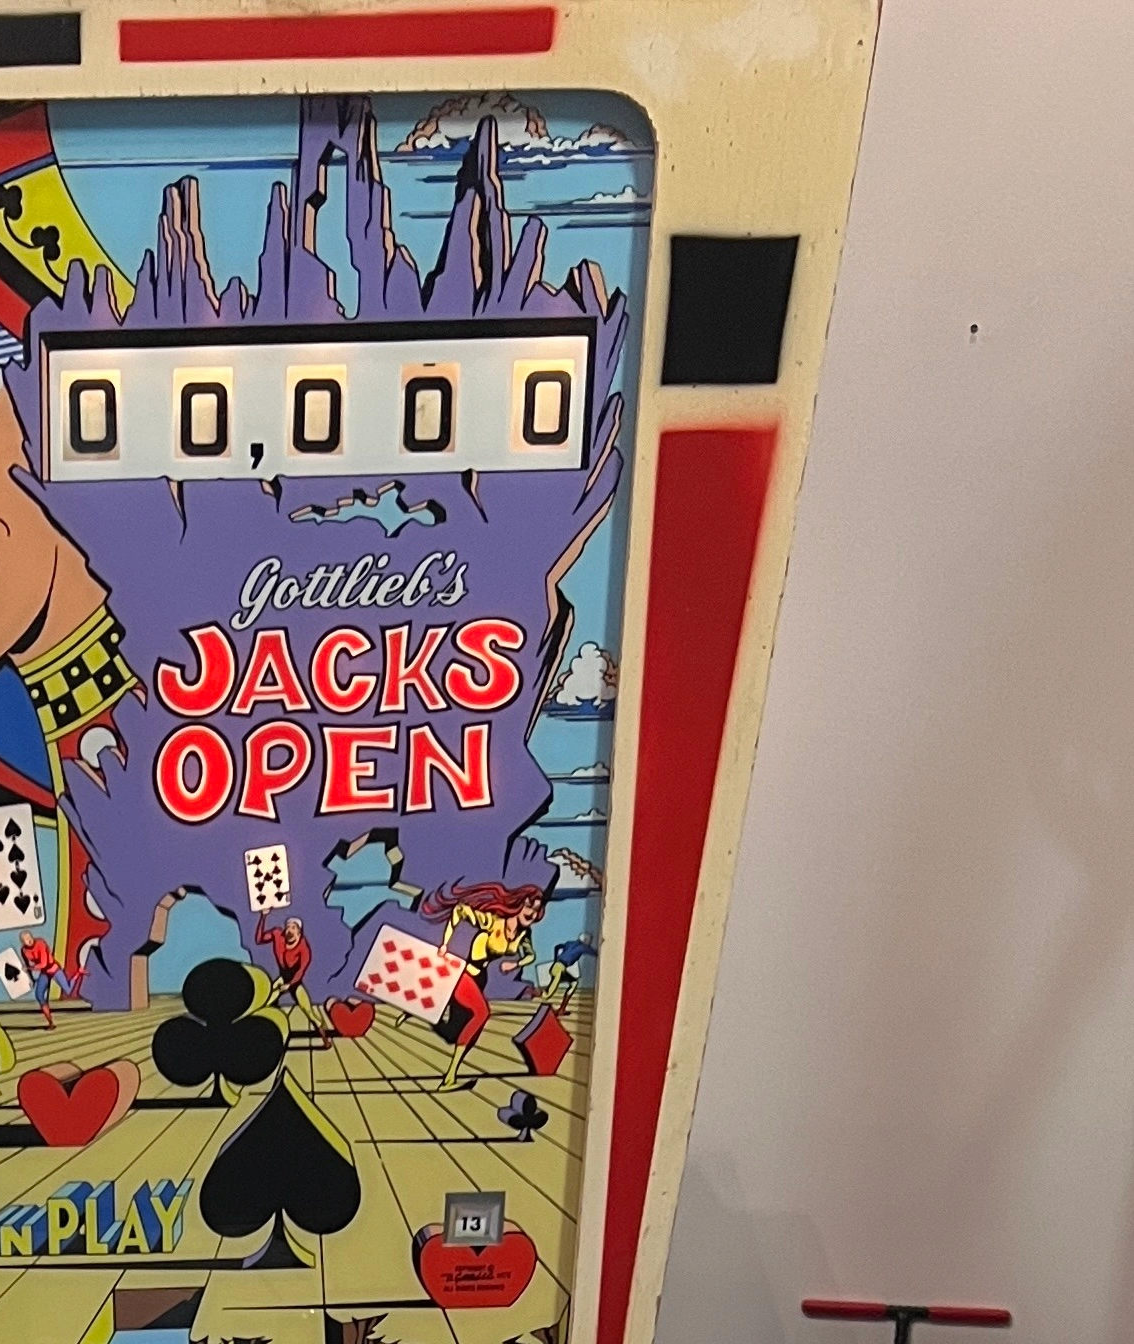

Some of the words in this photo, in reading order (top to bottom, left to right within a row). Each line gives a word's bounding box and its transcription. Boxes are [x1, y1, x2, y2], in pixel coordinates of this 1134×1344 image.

[230, 552, 468, 631] Gottlieb's
[155, 617, 526, 718] JACKS
[155, 721, 494, 825] OPEN
[48, 1188, 190, 1255] PLAY
[461, 1216, 481, 1231] 13
